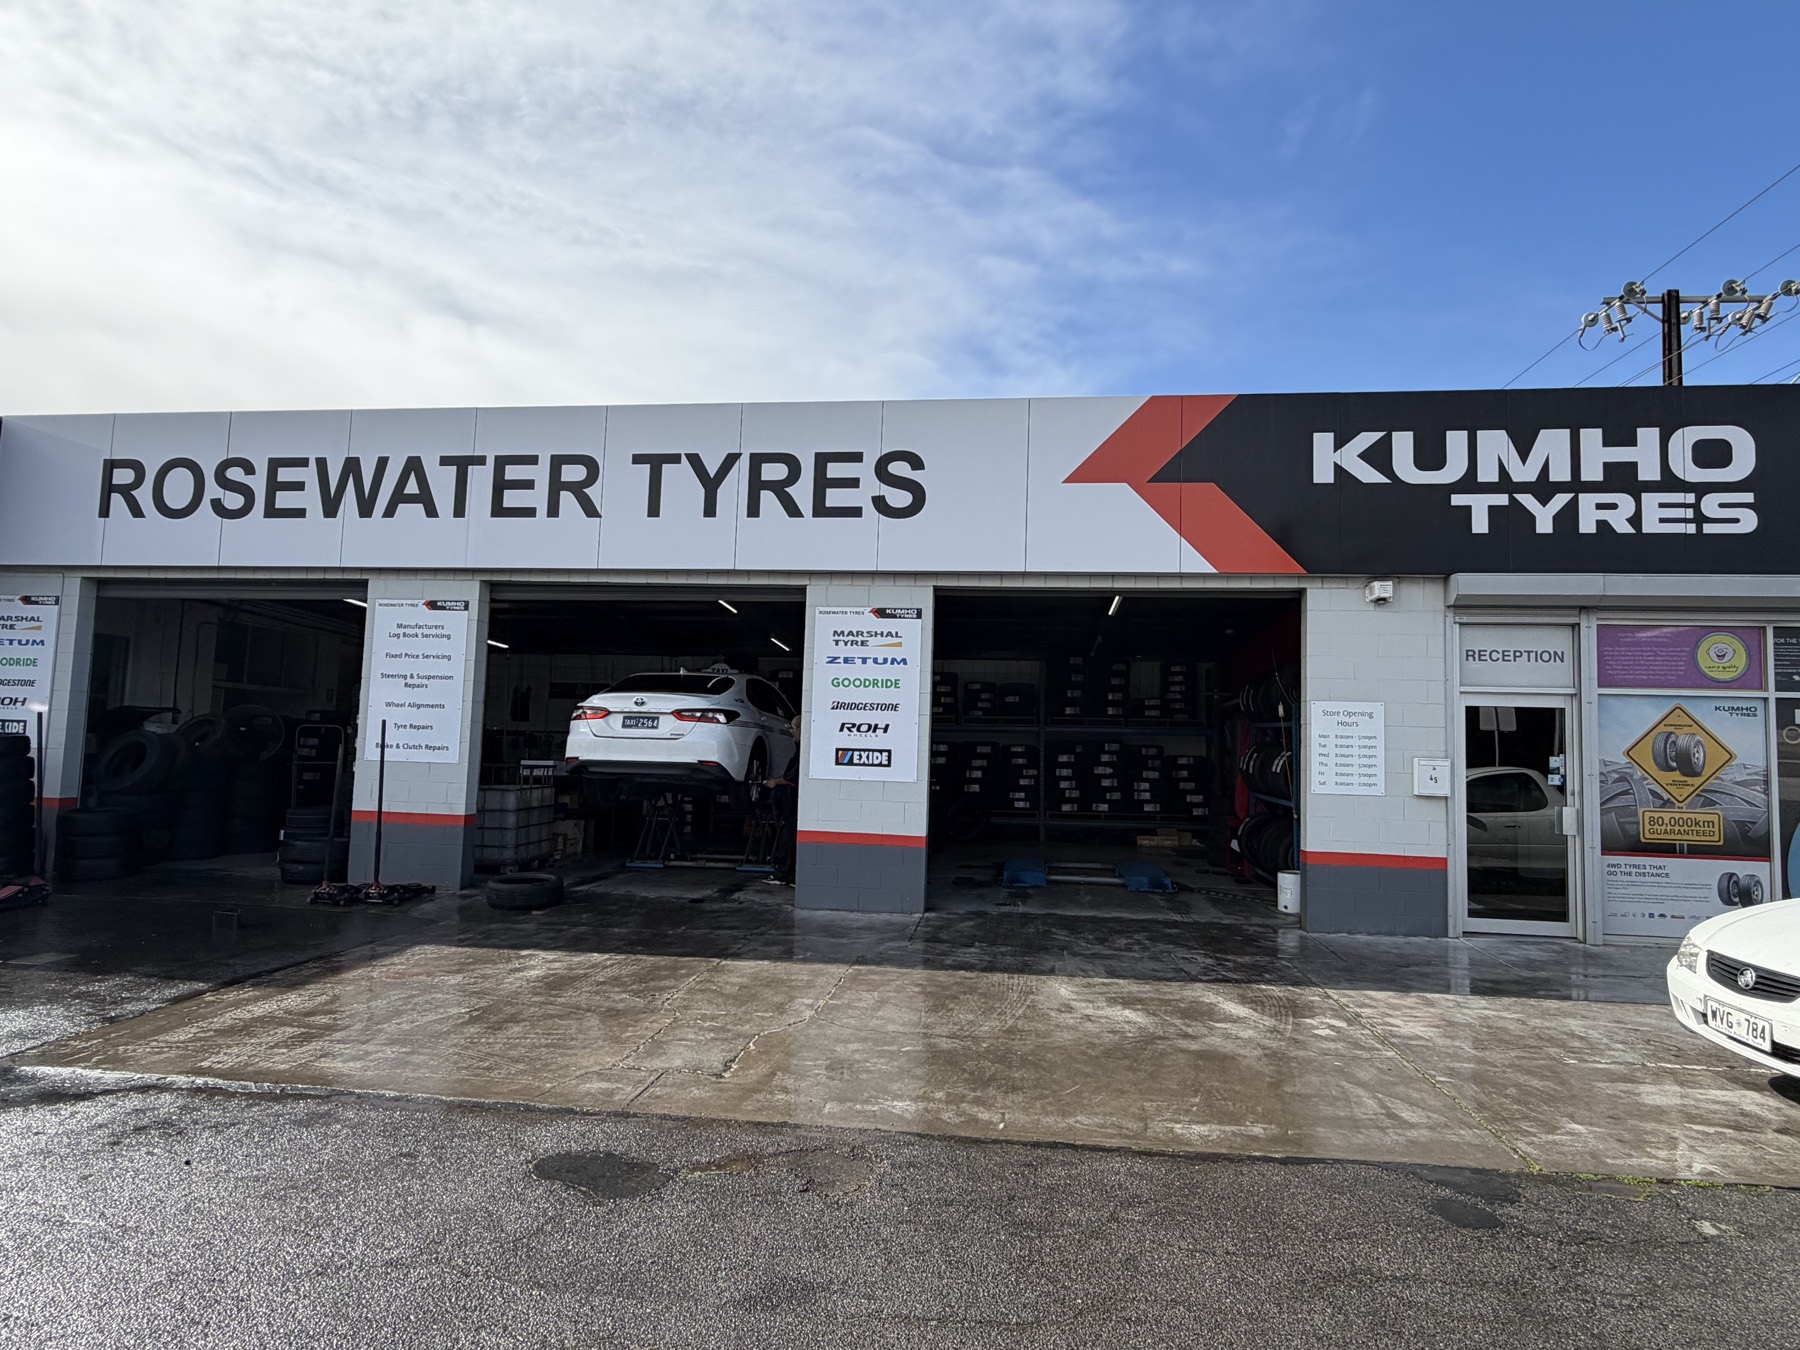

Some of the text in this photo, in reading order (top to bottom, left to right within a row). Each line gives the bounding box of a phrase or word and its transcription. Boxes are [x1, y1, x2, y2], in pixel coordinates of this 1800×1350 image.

[1312, 425, 1757, 485] KUMHO
[98, 450, 927, 520] ROSEWATER TYRES
[1450, 492, 1759, 534] TYRES
[388, 632, 400, 640] Log
[421, 632, 451, 640] Servicing
[832, 630, 903, 638] MARSHAL
[832, 639, 870, 647] TYRE
[421, 653, 452, 661] Servicing
[825, 656, 908, 666] ZETUM
[1465, 649, 1565, 663] RECEPTION
[380, 672, 408, 681] Steering
[416, 673, 454, 681] Suspension
[404, 682, 428, 690] Repairs
[831, 677, 901, 689] GOODRIDE
[407, 702, 445, 710] Alignments
[830, 700, 900, 712] BRIDGESTONE
[1322, 709, 1374, 719] Store Opening
[393, 723, 433, 731] Tyre Repairs
[638, 718, 658, 727] 2564
[838, 722, 890, 734] ROH
[424, 744, 449, 752] Repairs
[853, 751, 889, 765] EXIDE
[1648, 816, 1715, 829] 80,000km
[1648, 828, 1716, 838] GUARANTEED
[1710, 1004, 1734, 1030] WVG
[1744, 1017, 1766, 1043] 784
